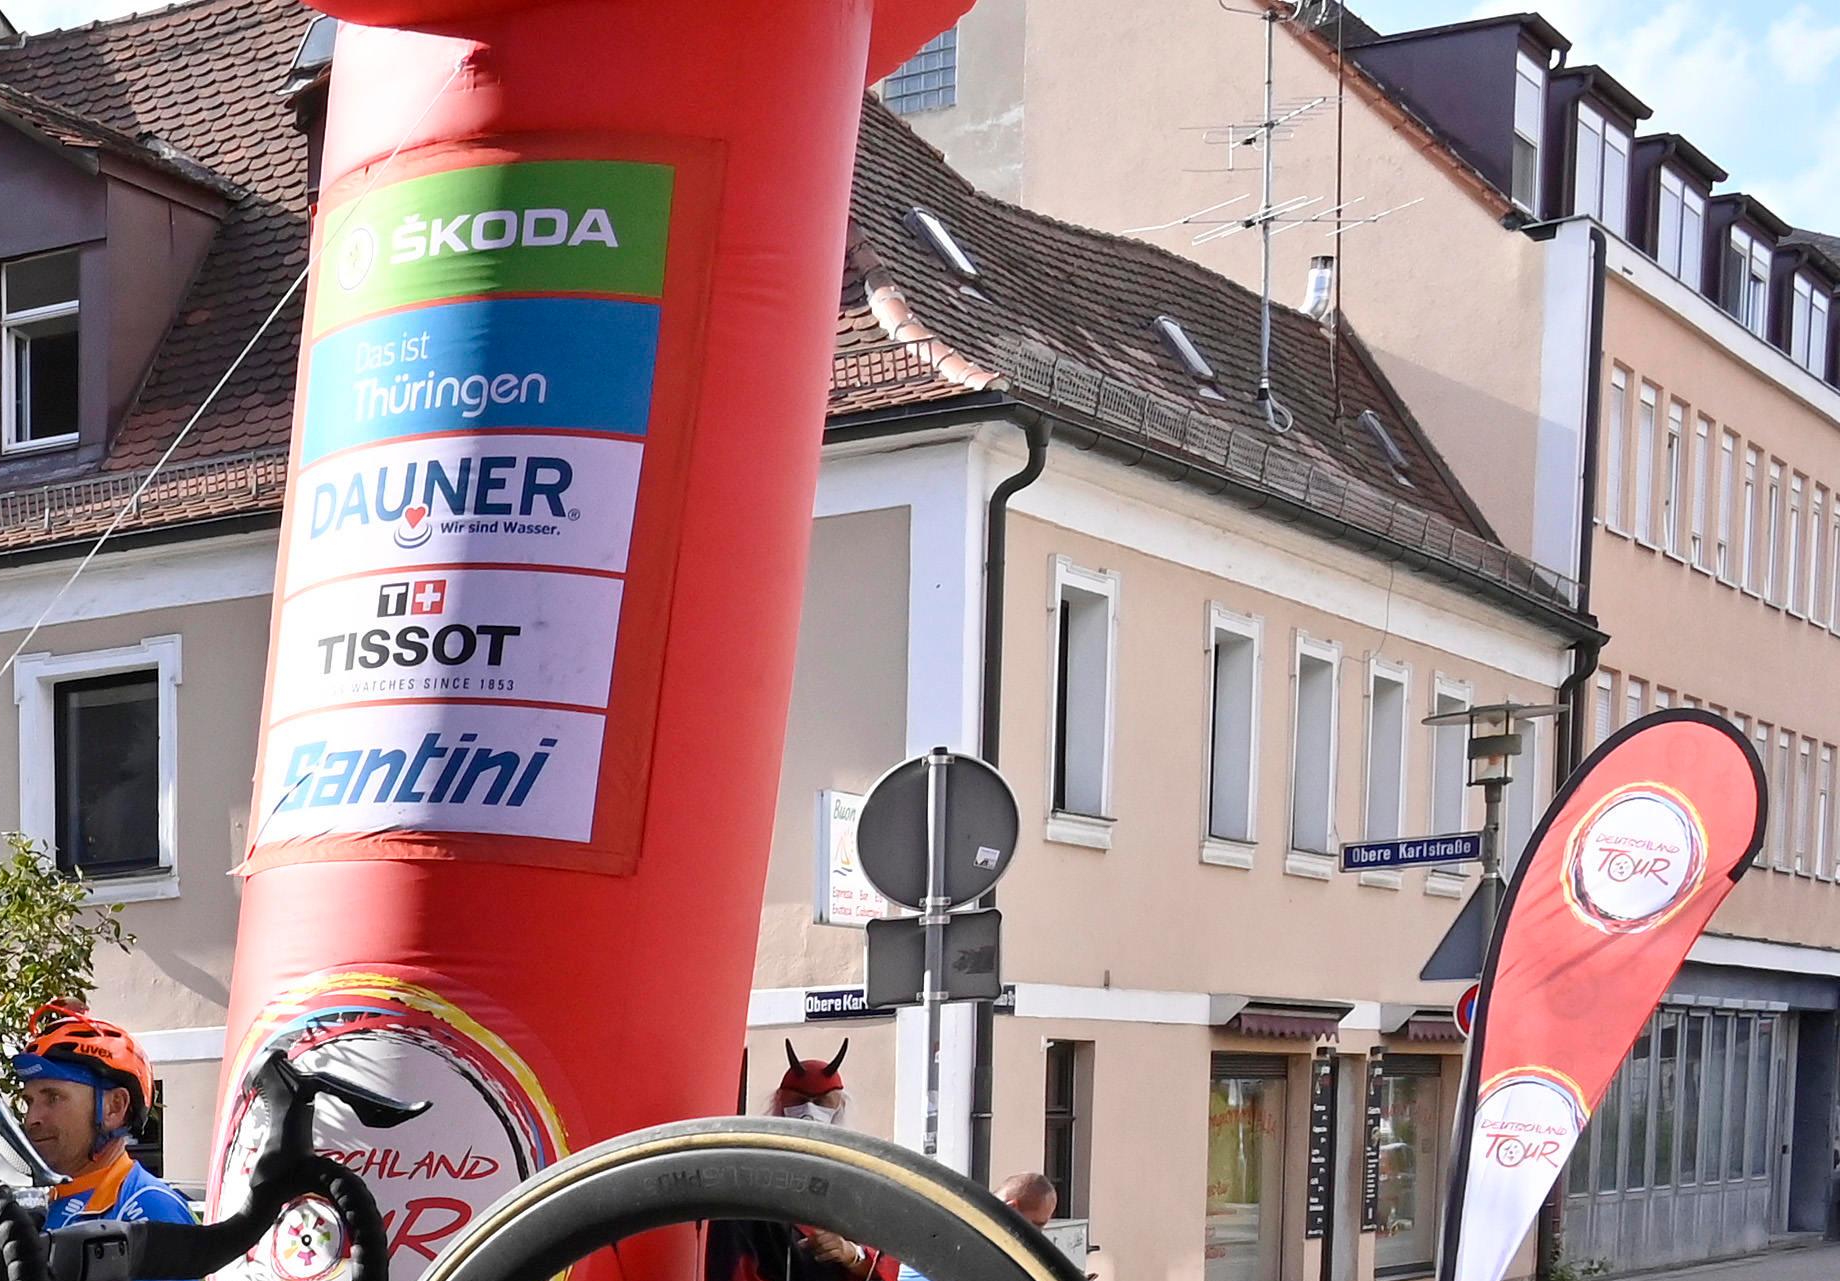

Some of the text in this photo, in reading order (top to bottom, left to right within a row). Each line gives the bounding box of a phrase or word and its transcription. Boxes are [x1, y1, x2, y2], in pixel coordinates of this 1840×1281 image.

[389, 208, 619, 265] ŠKODA
[355, 331, 431, 374] Das ist
[353, 371, 547, 422] Thüringen
[310, 456, 574, 540] DAUNER
[440, 522, 466, 535] Wir
[469, 521, 498, 534] sind
[317, 624, 521, 675] TISSOT
[351, 678, 415, 692] WATCHES
[423, 677, 470, 690] SINCE
[479, 678, 515, 691] 1853
[278, 732, 559, 813] Santini
[1352, 841, 1472, 864] Obere Karlstraße
[1596, 833, 1681, 854] DEUTSCHLAND
[1599, 848, 1670, 886] TOUR
[806, 994, 841, 1013] Obere
[80, 1042, 114, 1060] uvex
[1481, 1119, 1568, 1137] DEUTSCHLAND
[1486, 1133, 1561, 1168] TOUR
